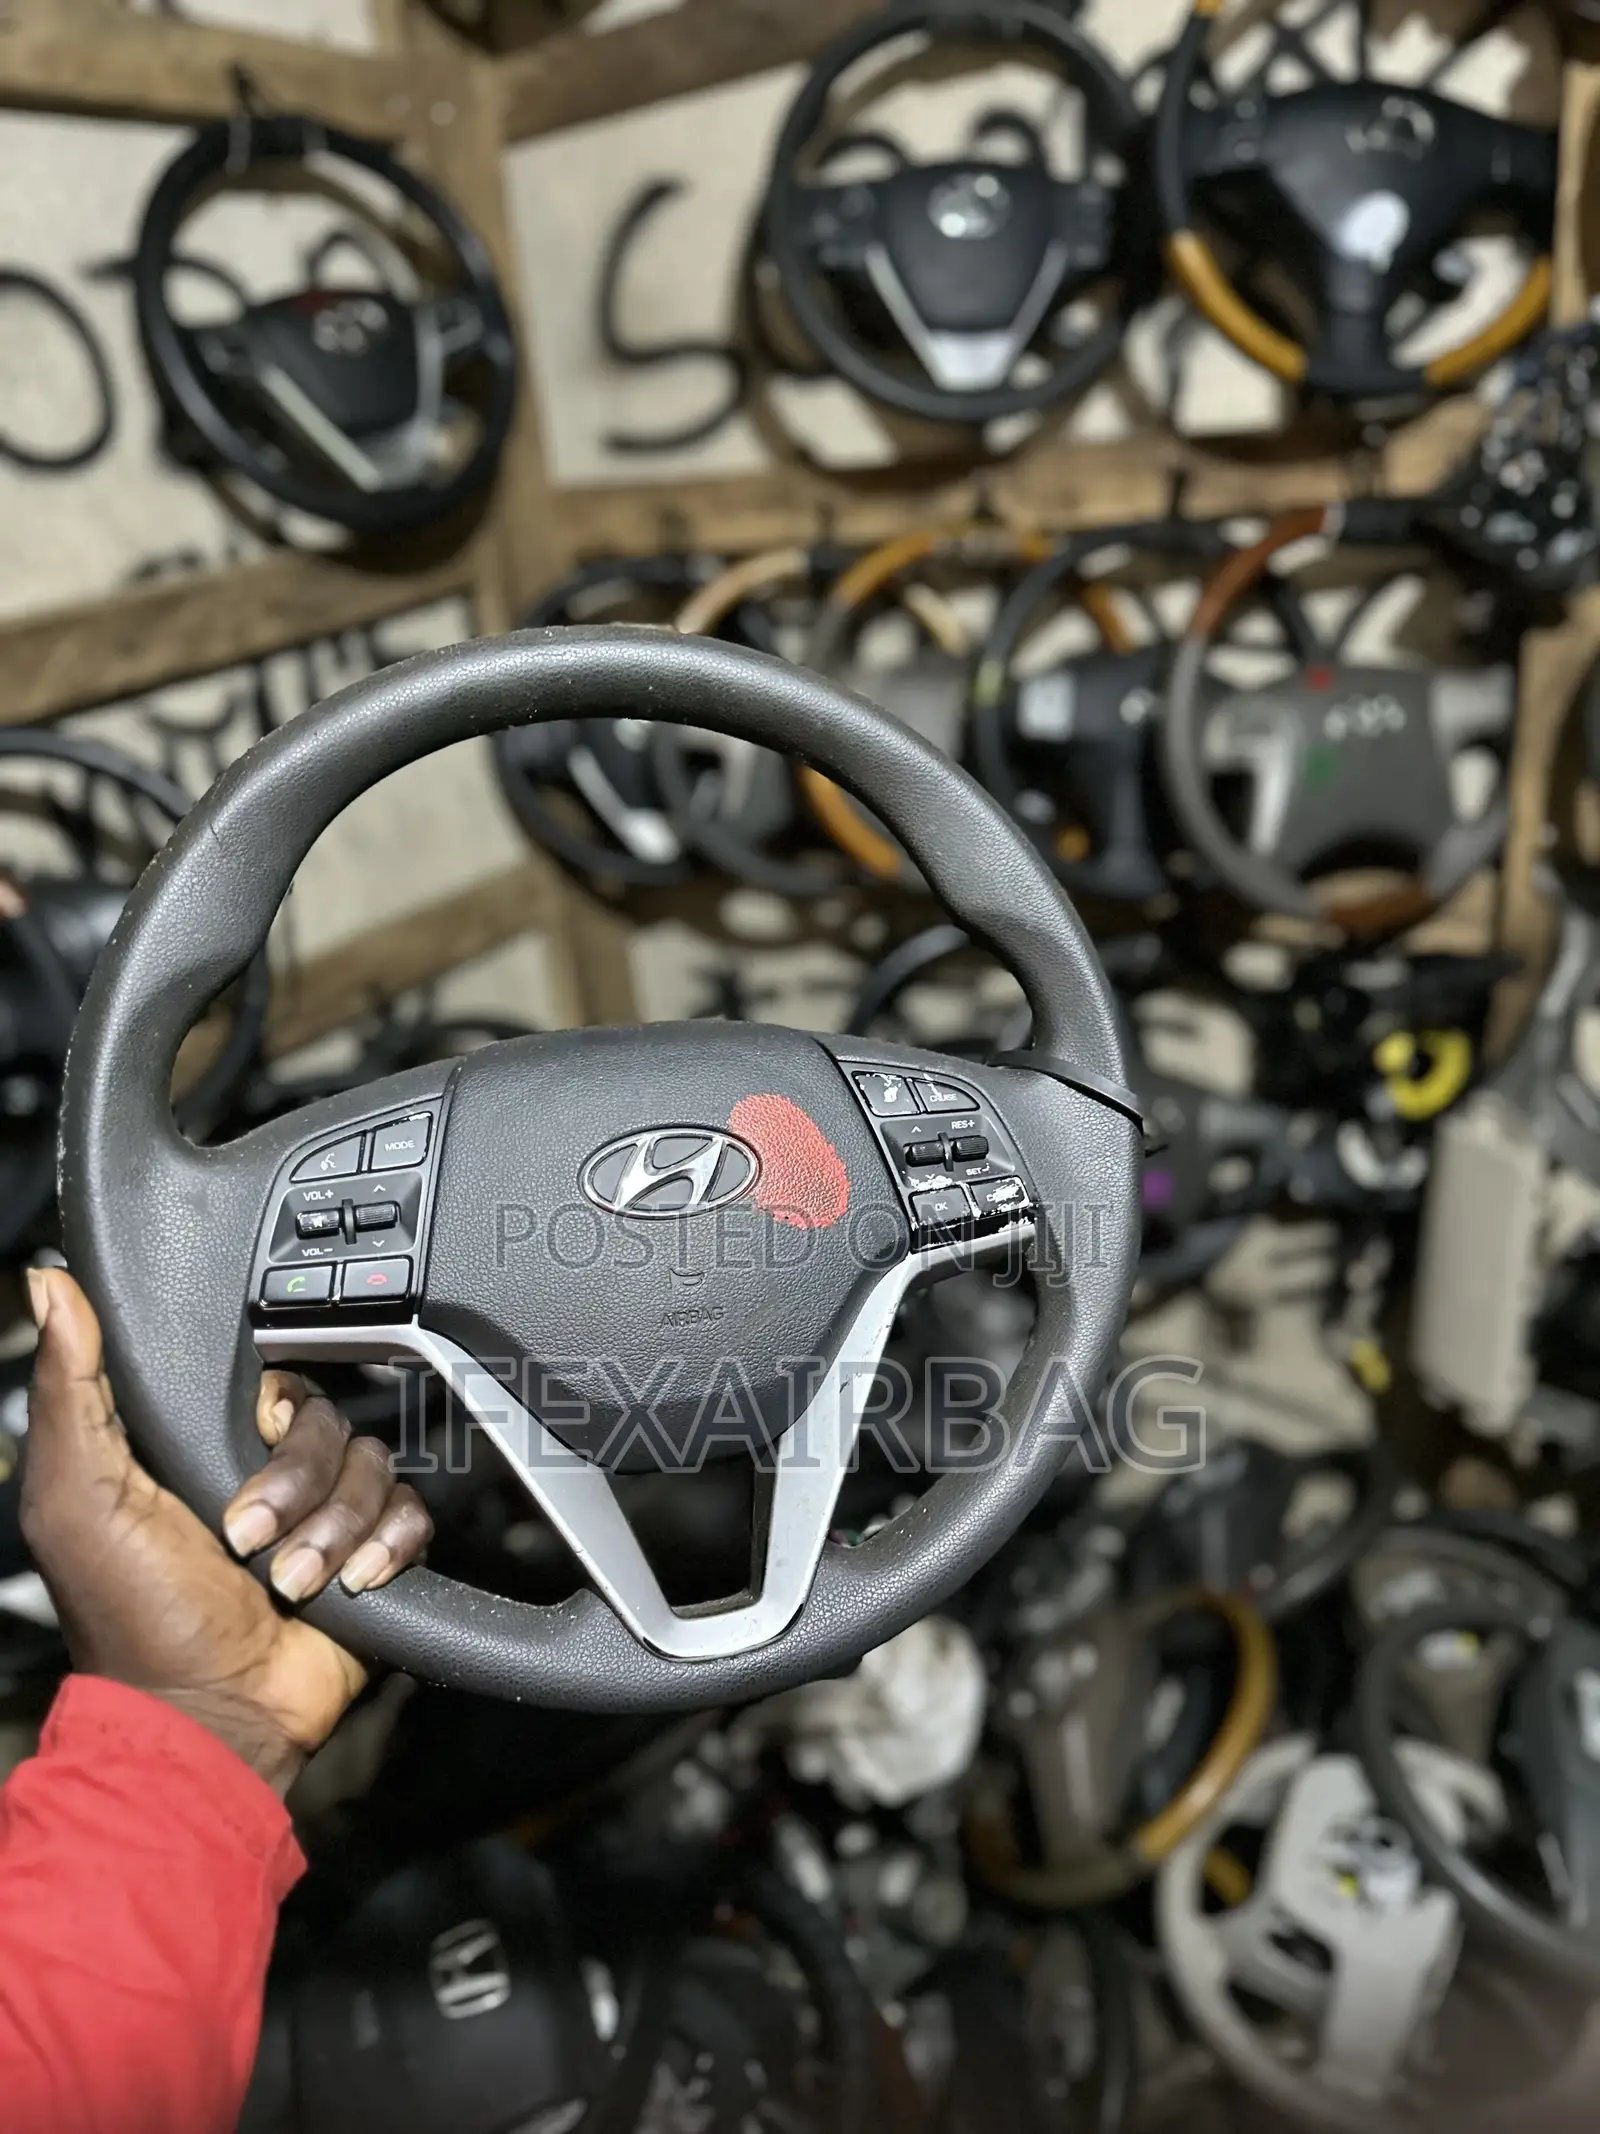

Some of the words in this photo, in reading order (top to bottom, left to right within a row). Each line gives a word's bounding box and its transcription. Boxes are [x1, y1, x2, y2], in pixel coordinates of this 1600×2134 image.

[929, 1093, 958, 1103] CRUISE
[951, 1120, 975, 1130] RES+
[384, 1139, 415, 1152] MODE
[303, 1189, 334, 1202] VOL+
[934, 1202, 948, 1212] OK
[660, 1306, 724, 1328] AIRBAG
